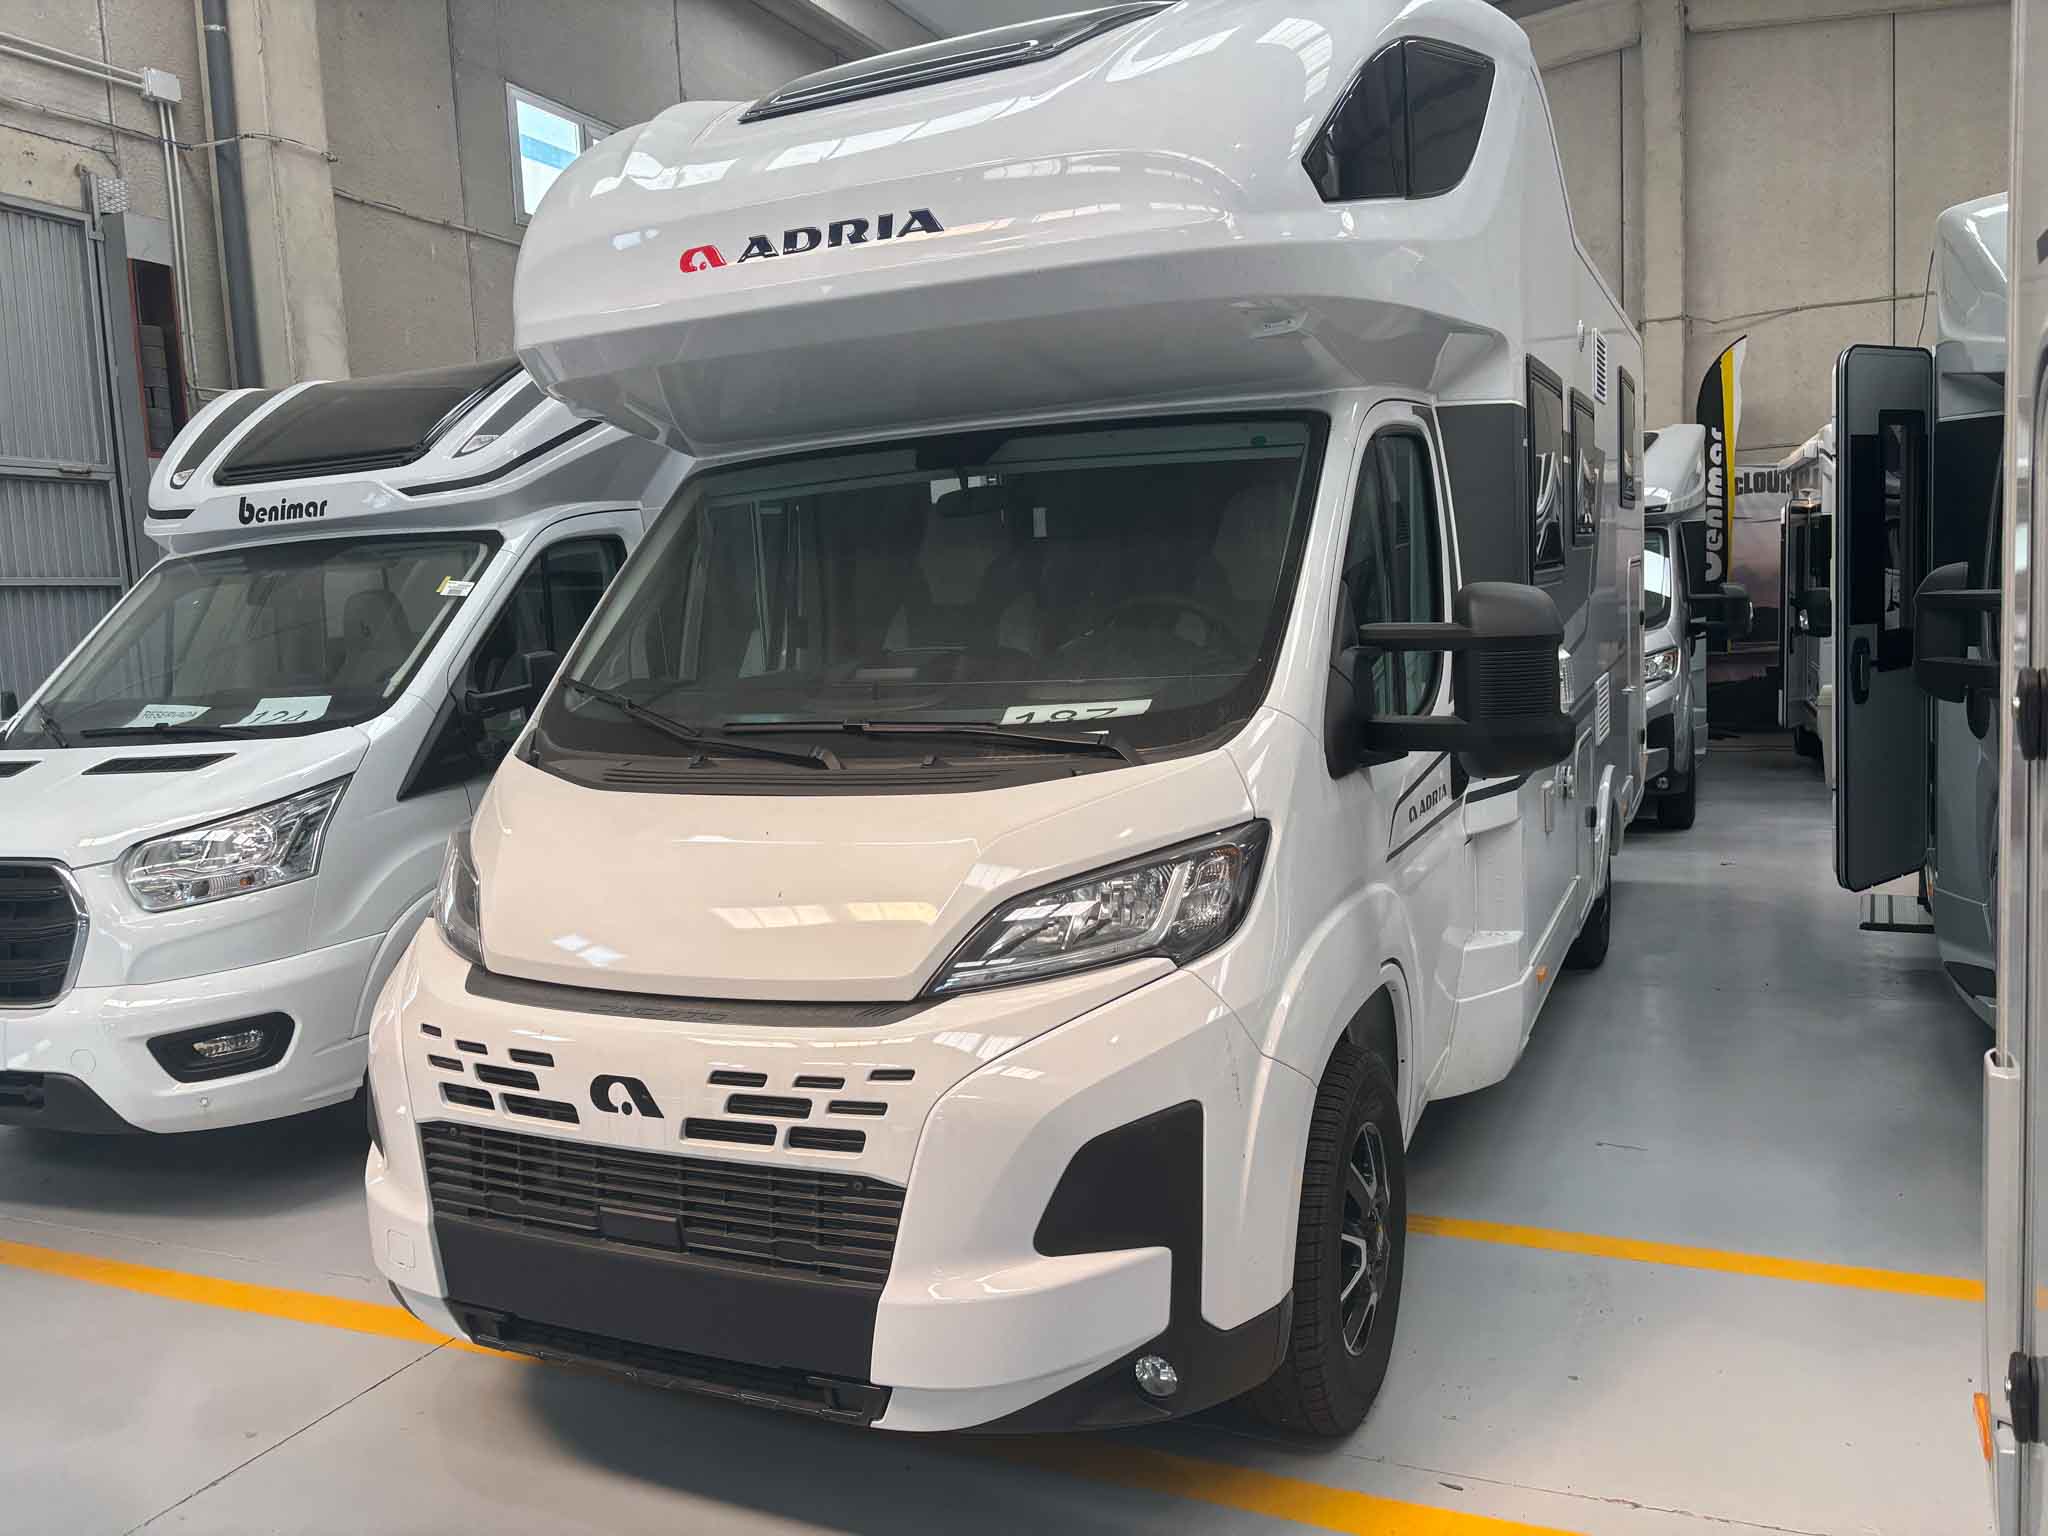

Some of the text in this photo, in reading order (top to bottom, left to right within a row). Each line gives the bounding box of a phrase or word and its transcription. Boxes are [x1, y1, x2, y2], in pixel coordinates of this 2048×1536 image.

[736, 207, 945, 264] ADRIA
[238, 496, 328, 525] benimar
[1419, 783, 1447, 817] ADRIA
